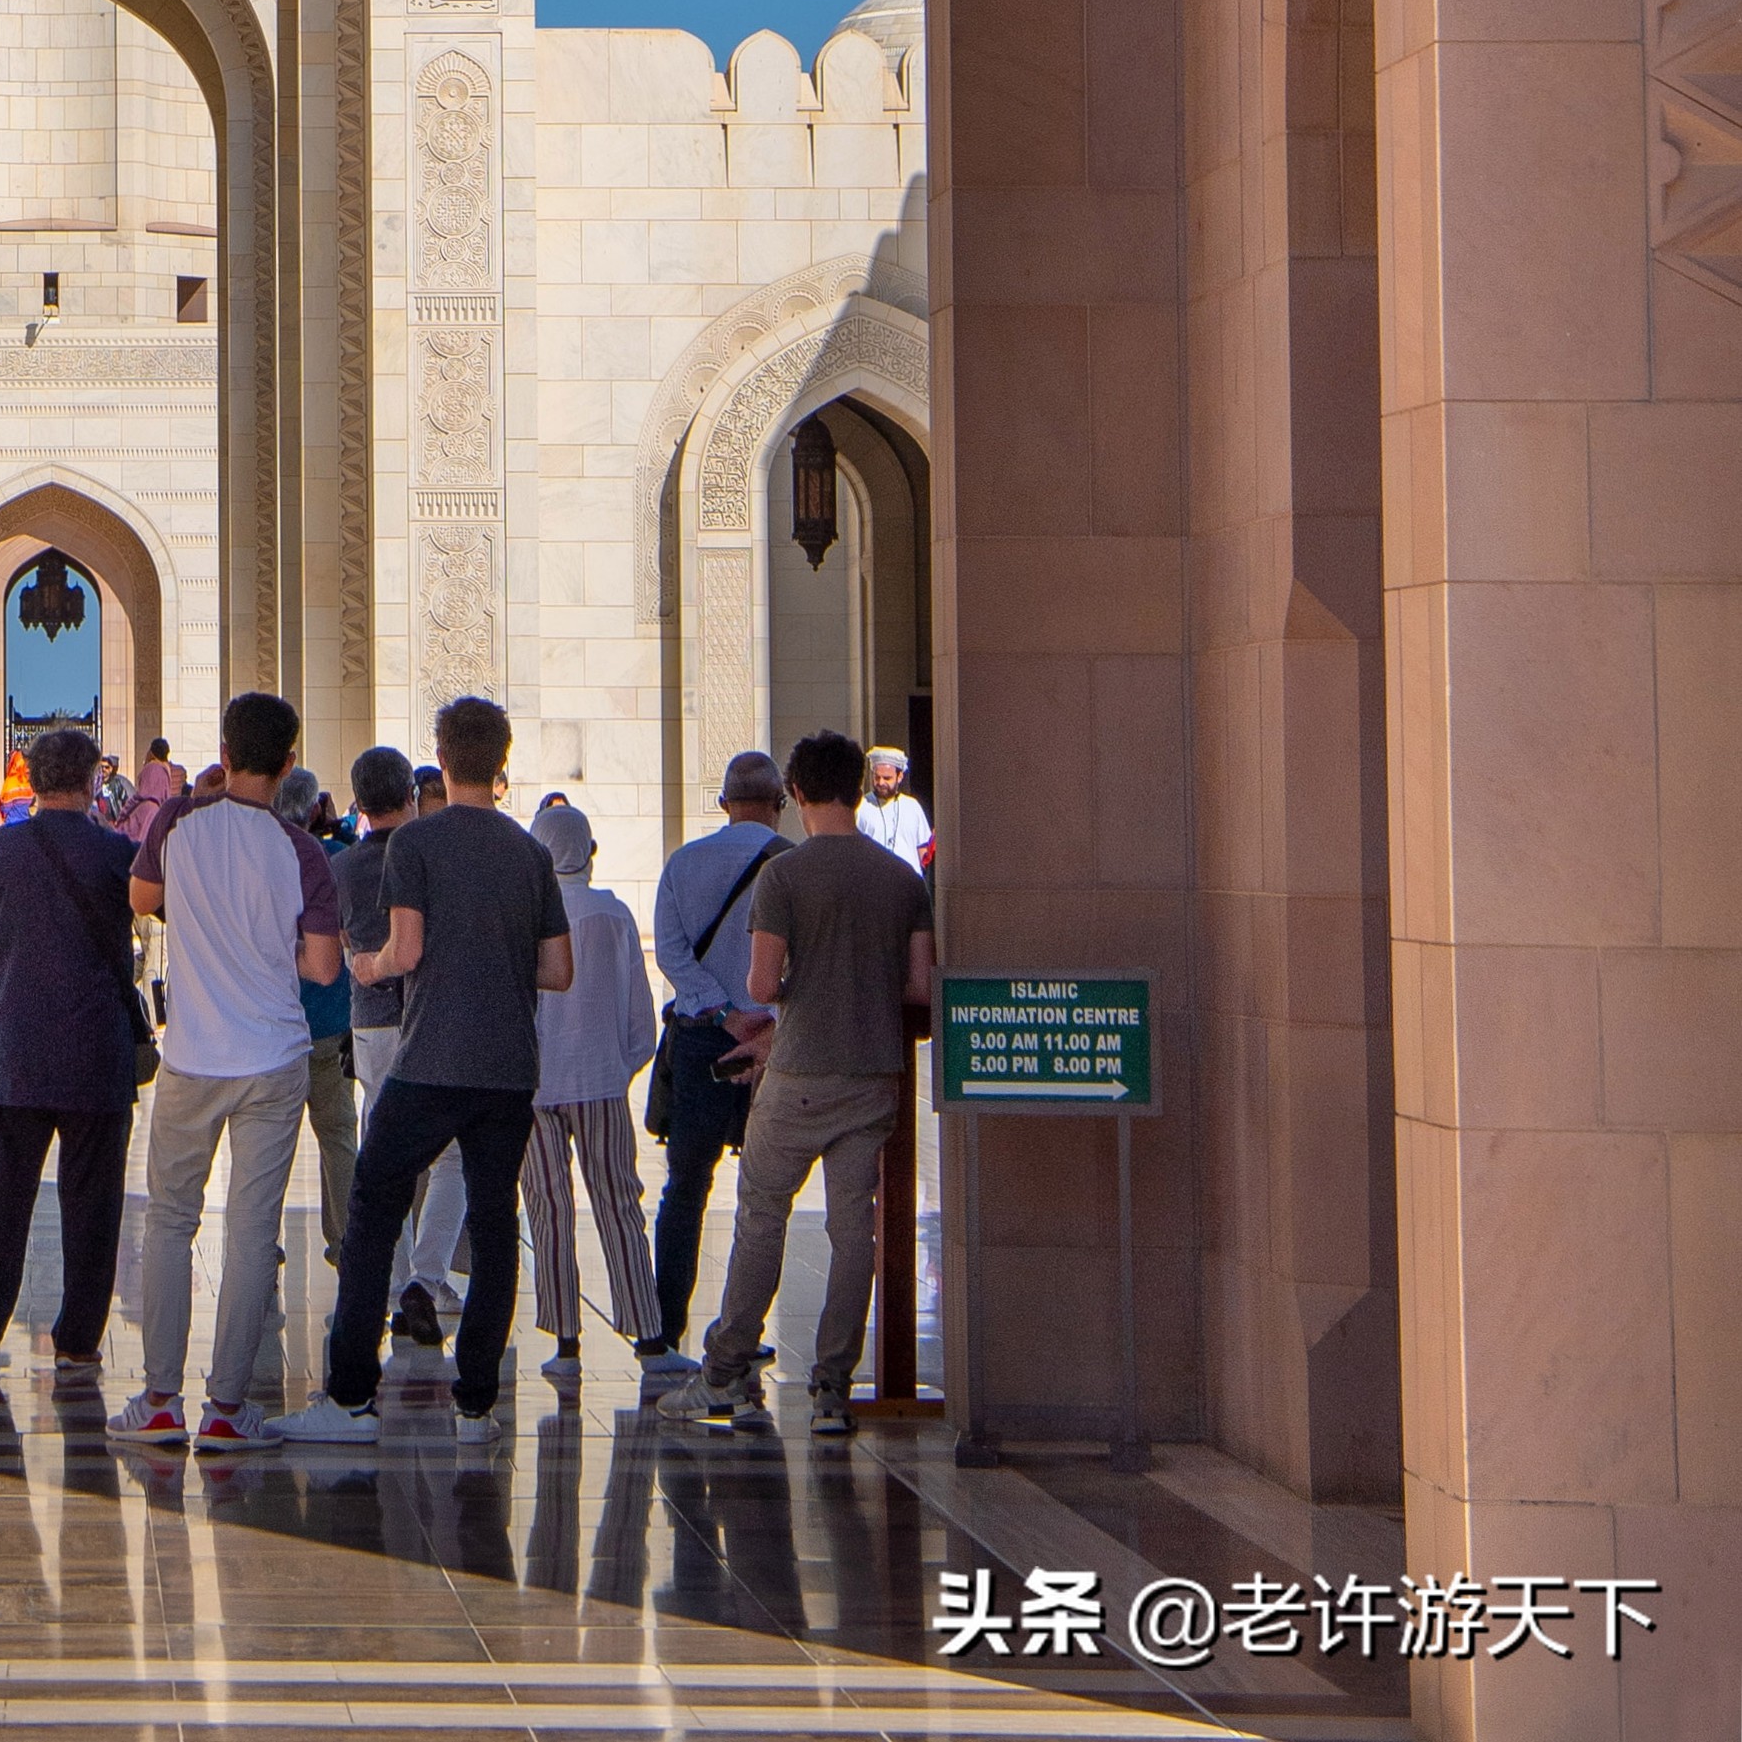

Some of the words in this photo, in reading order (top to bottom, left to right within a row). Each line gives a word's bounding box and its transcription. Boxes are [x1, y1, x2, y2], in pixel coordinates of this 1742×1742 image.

[1011, 982, 1078, 998] ISLAMIC
[951, 1006, 1067, 1024] INFORMATION
[1072, 1007, 1140, 1025] CENTRE
[970, 1032, 1007, 1050] 9.00
[1011, 1033, 1038, 1050] AM
[1044, 1033, 1090, 1051] 11.00
[1096, 1034, 1121, 1051] AM
[970, 1056, 1007, 1072] 5.00
[1012, 1057, 1038, 1073] PM
[1053, 1057, 1090, 1073] 8.00
[1095, 1058, 1121, 1074] PM
